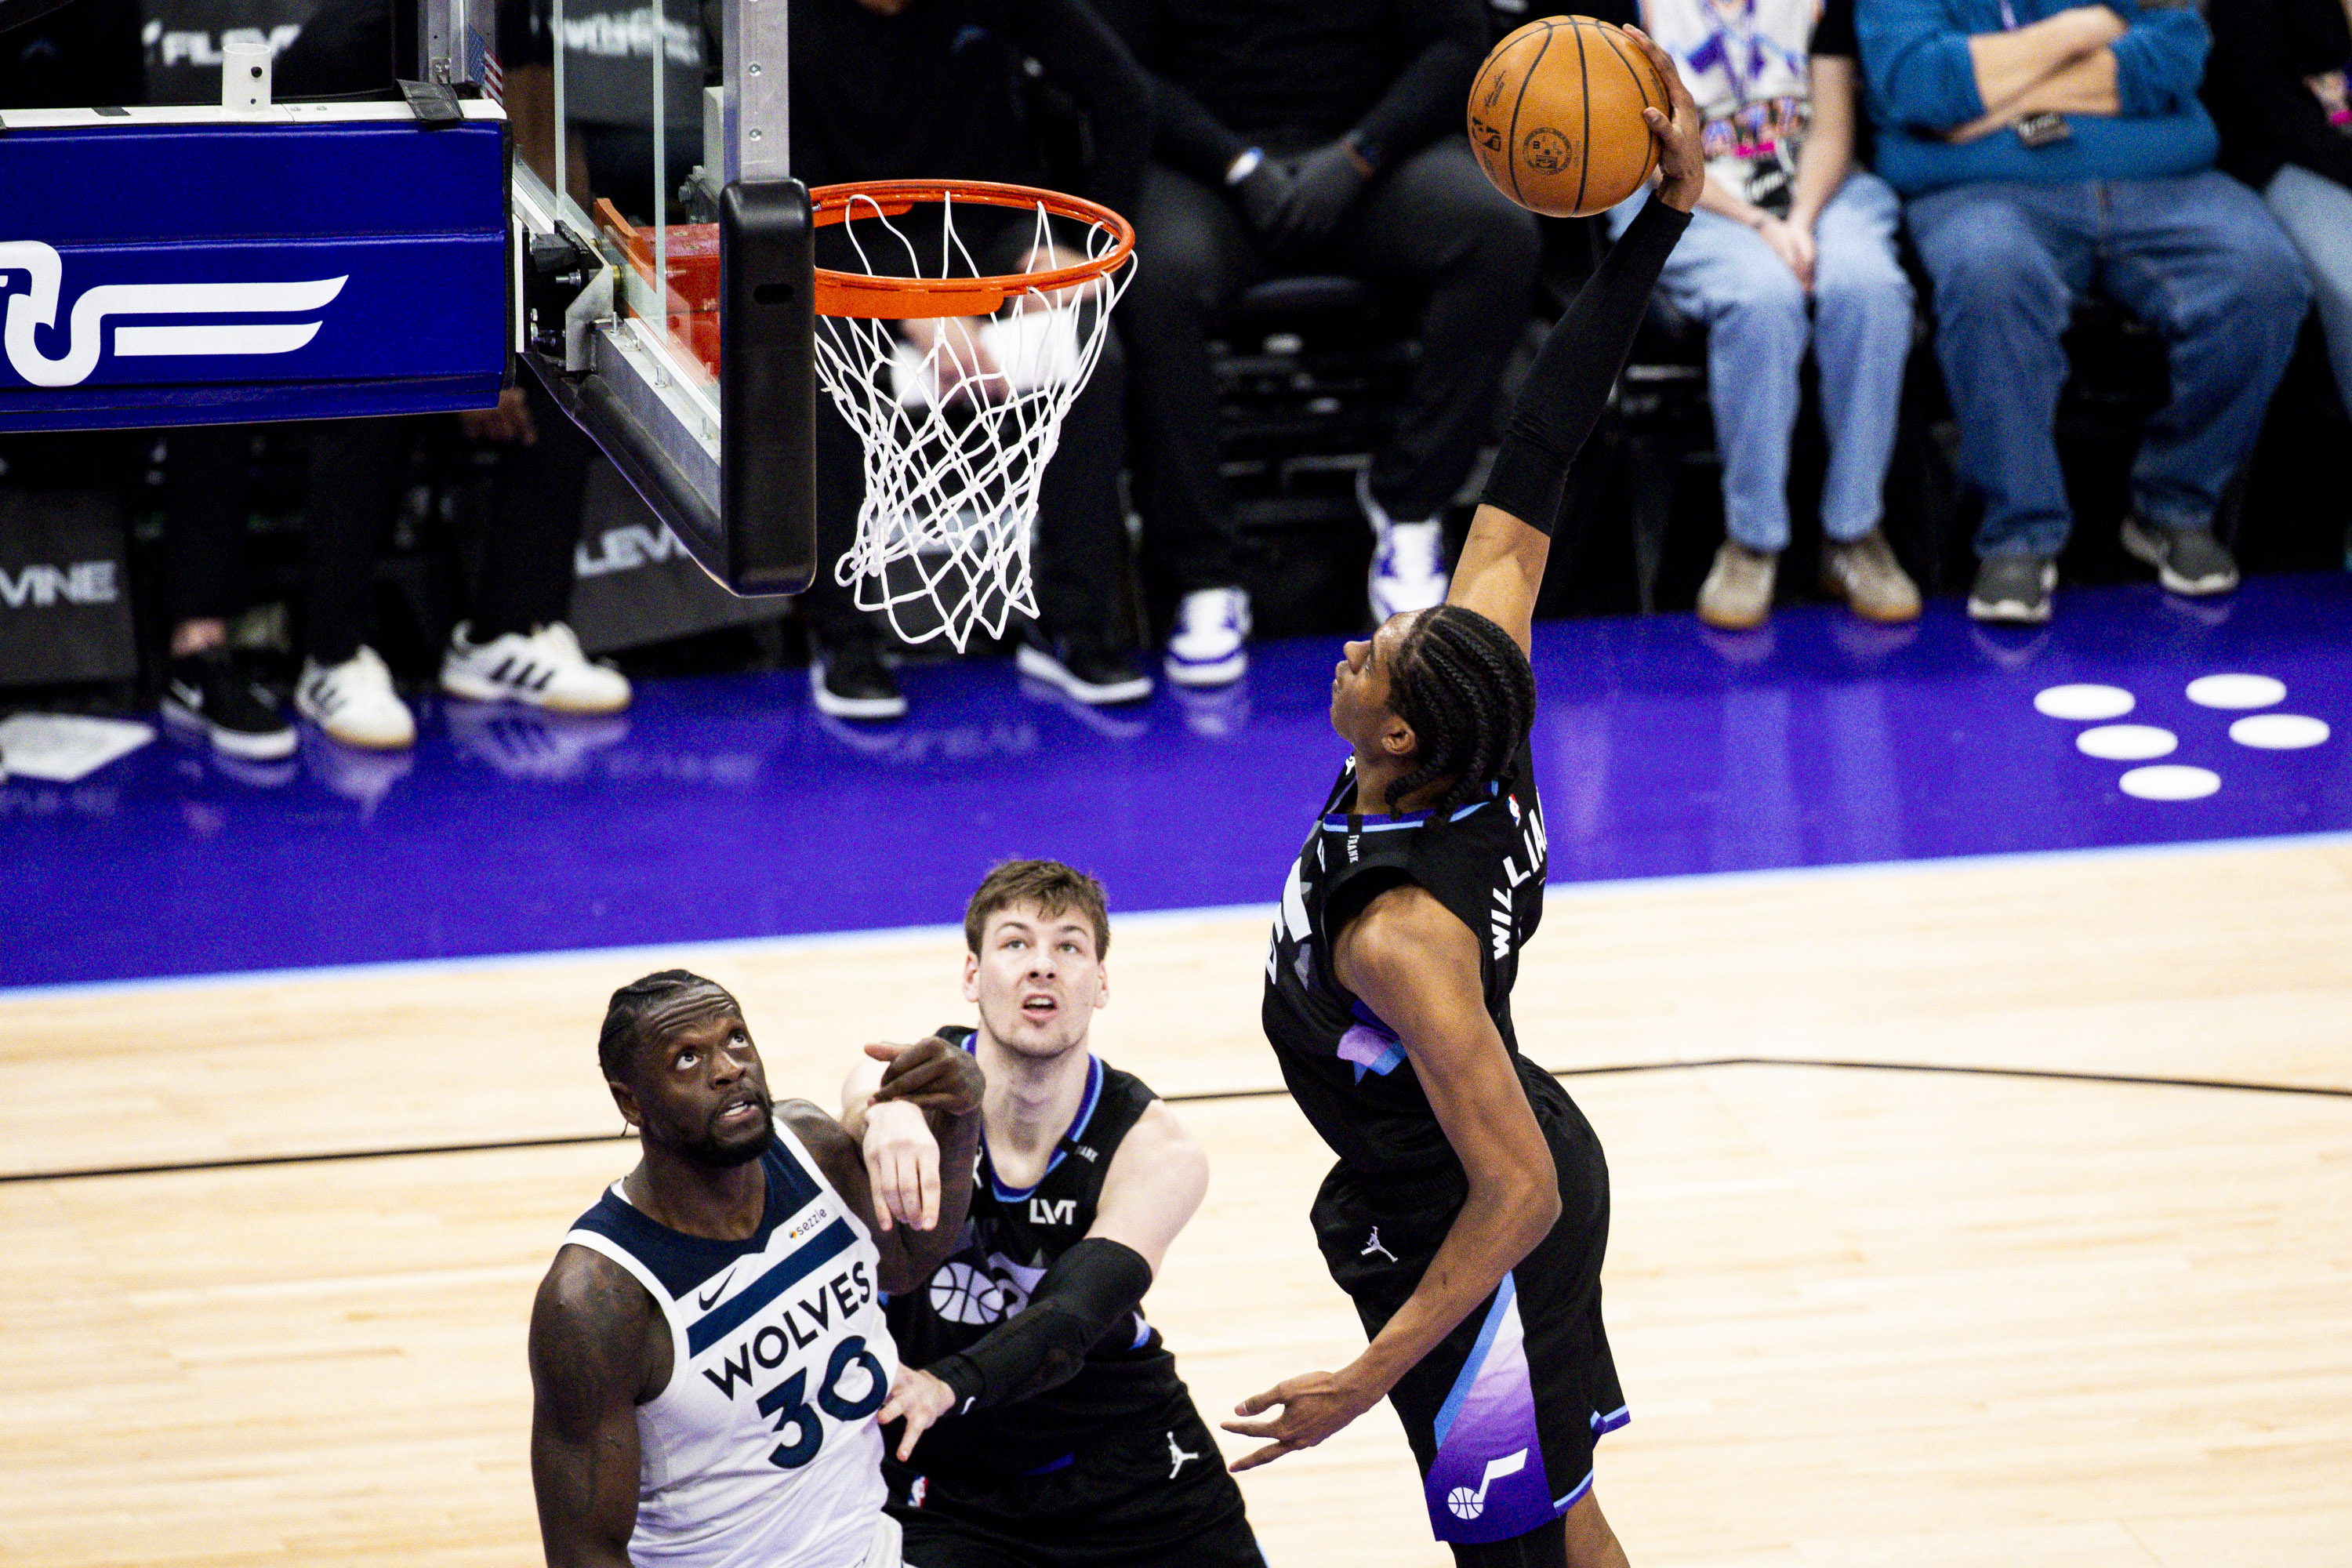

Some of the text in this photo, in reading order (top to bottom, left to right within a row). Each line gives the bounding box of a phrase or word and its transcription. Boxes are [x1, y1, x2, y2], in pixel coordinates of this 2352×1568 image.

[1491, 786, 1548, 961] WILLIA
[796, 1208, 827, 1236] sezzle
[1029, 1198, 1078, 1225] LVT
[702, 1261, 870, 1402] WOLVES
[756, 1334, 888, 1469] 30
